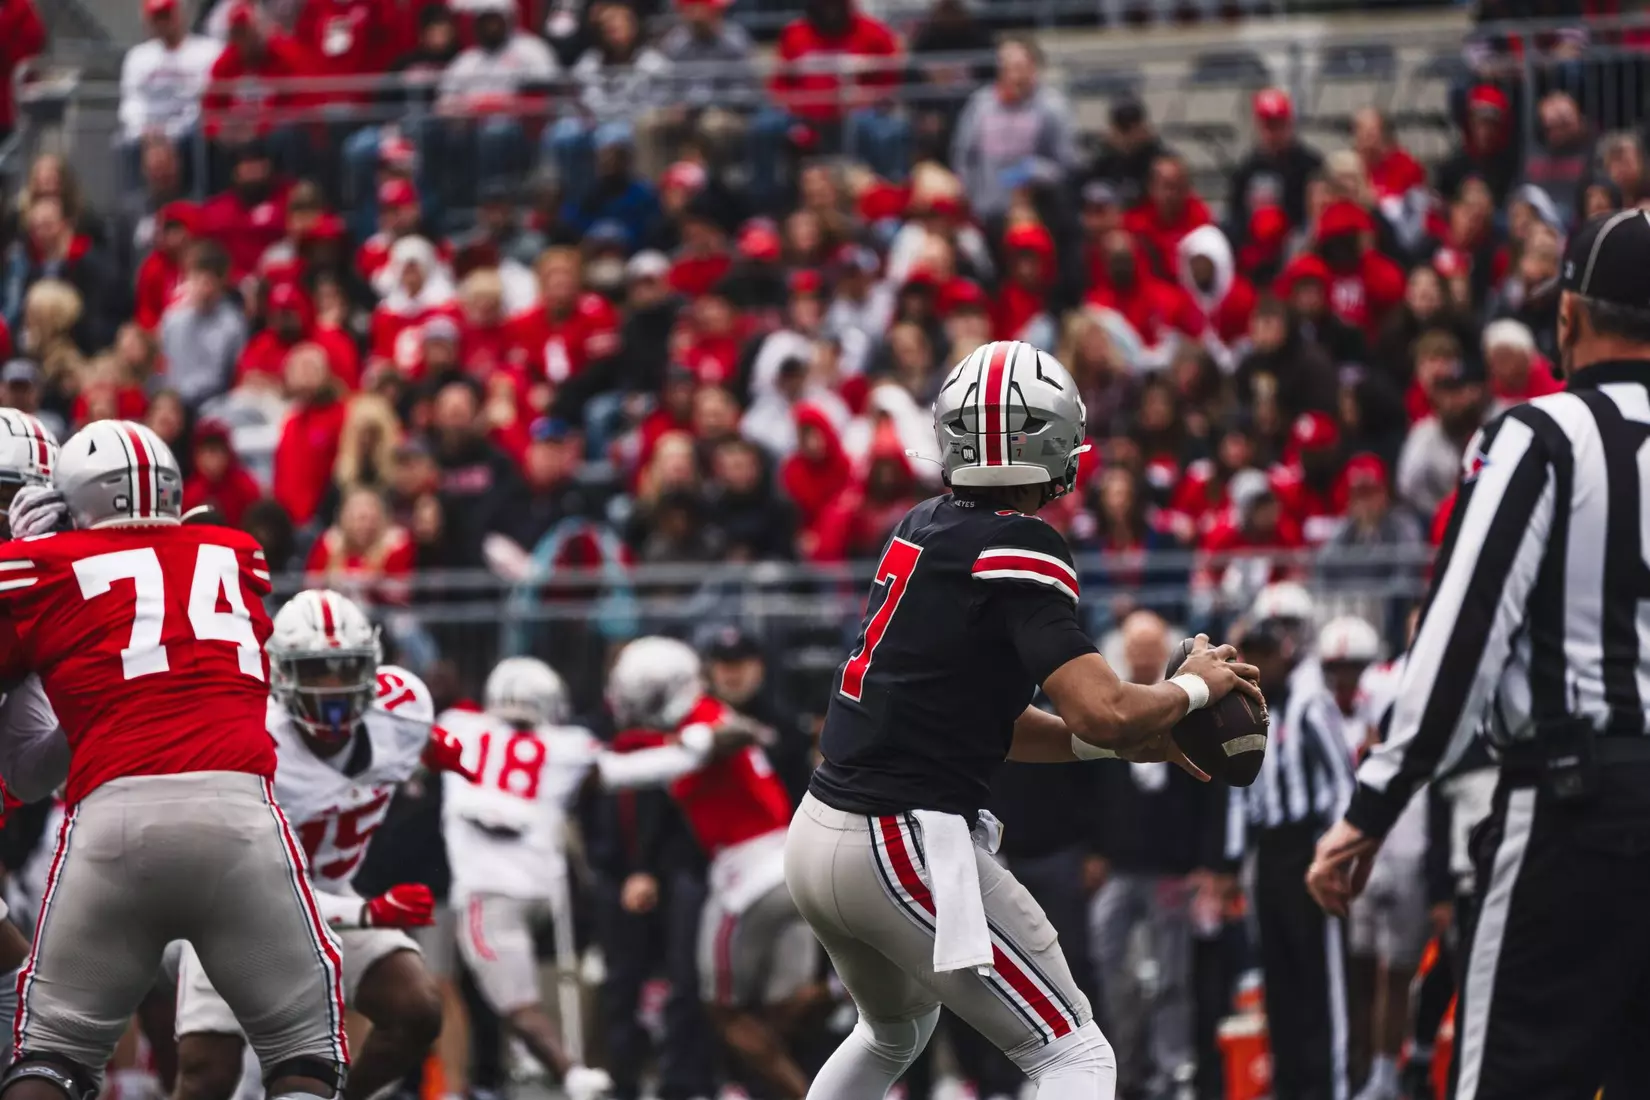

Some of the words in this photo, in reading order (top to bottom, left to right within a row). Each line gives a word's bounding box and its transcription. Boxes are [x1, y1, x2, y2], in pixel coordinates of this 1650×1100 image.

[72, 543, 265, 682] 74
[839, 535, 924, 703] 7
[473, 730, 546, 801] 18
